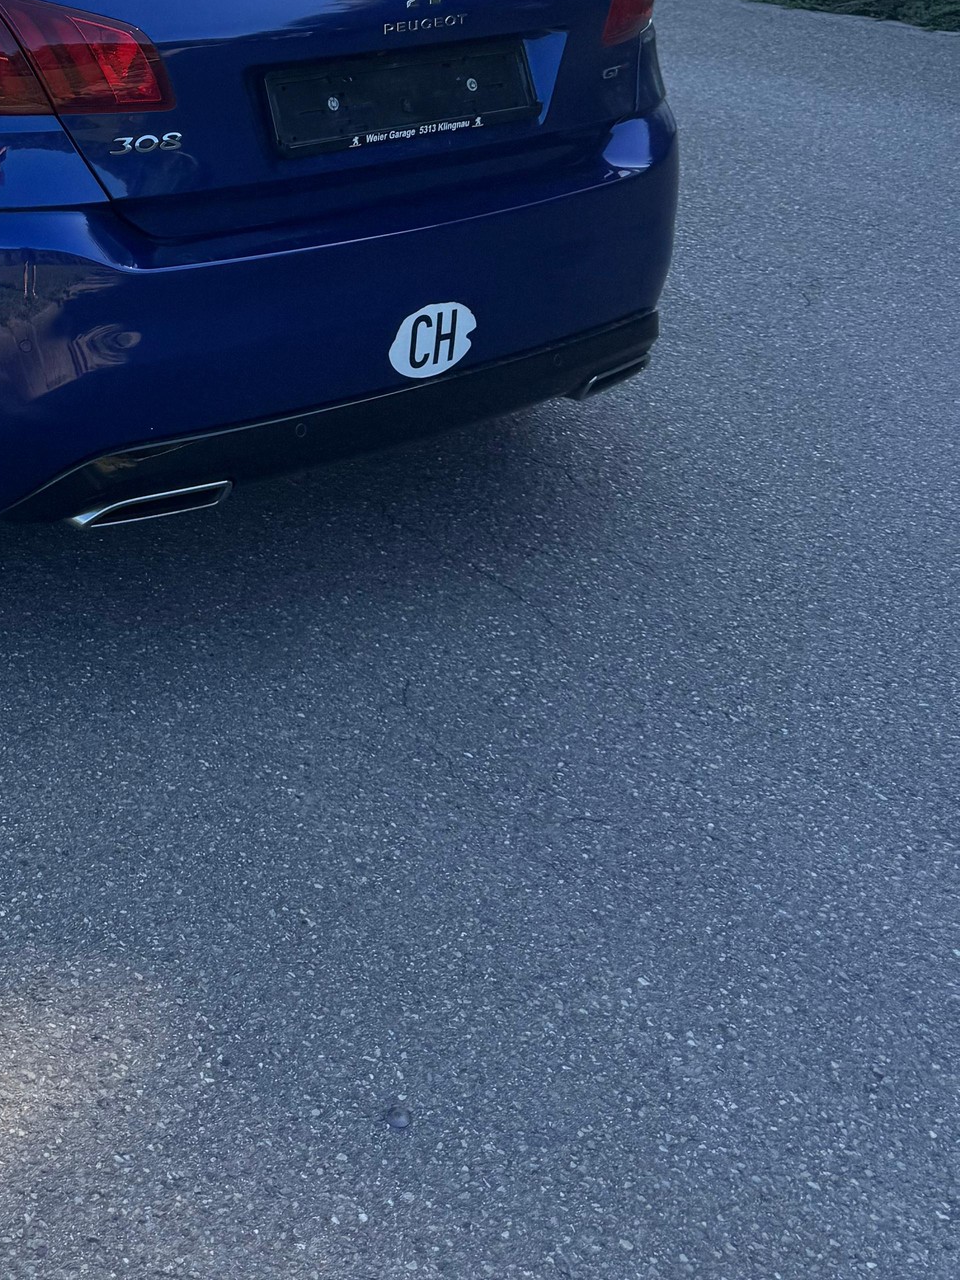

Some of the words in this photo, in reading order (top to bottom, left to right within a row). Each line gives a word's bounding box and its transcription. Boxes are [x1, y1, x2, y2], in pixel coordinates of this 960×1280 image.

[383, 13, 468, 35] PEUGEOT
[109, 132, 183, 155] 308
[366, 132, 388, 144] Weier
[389, 128, 416, 140] Garage
[419, 123, 437, 135] 5313
[438, 120, 471, 132] Klingnau
[409, 309, 458, 369] CH
